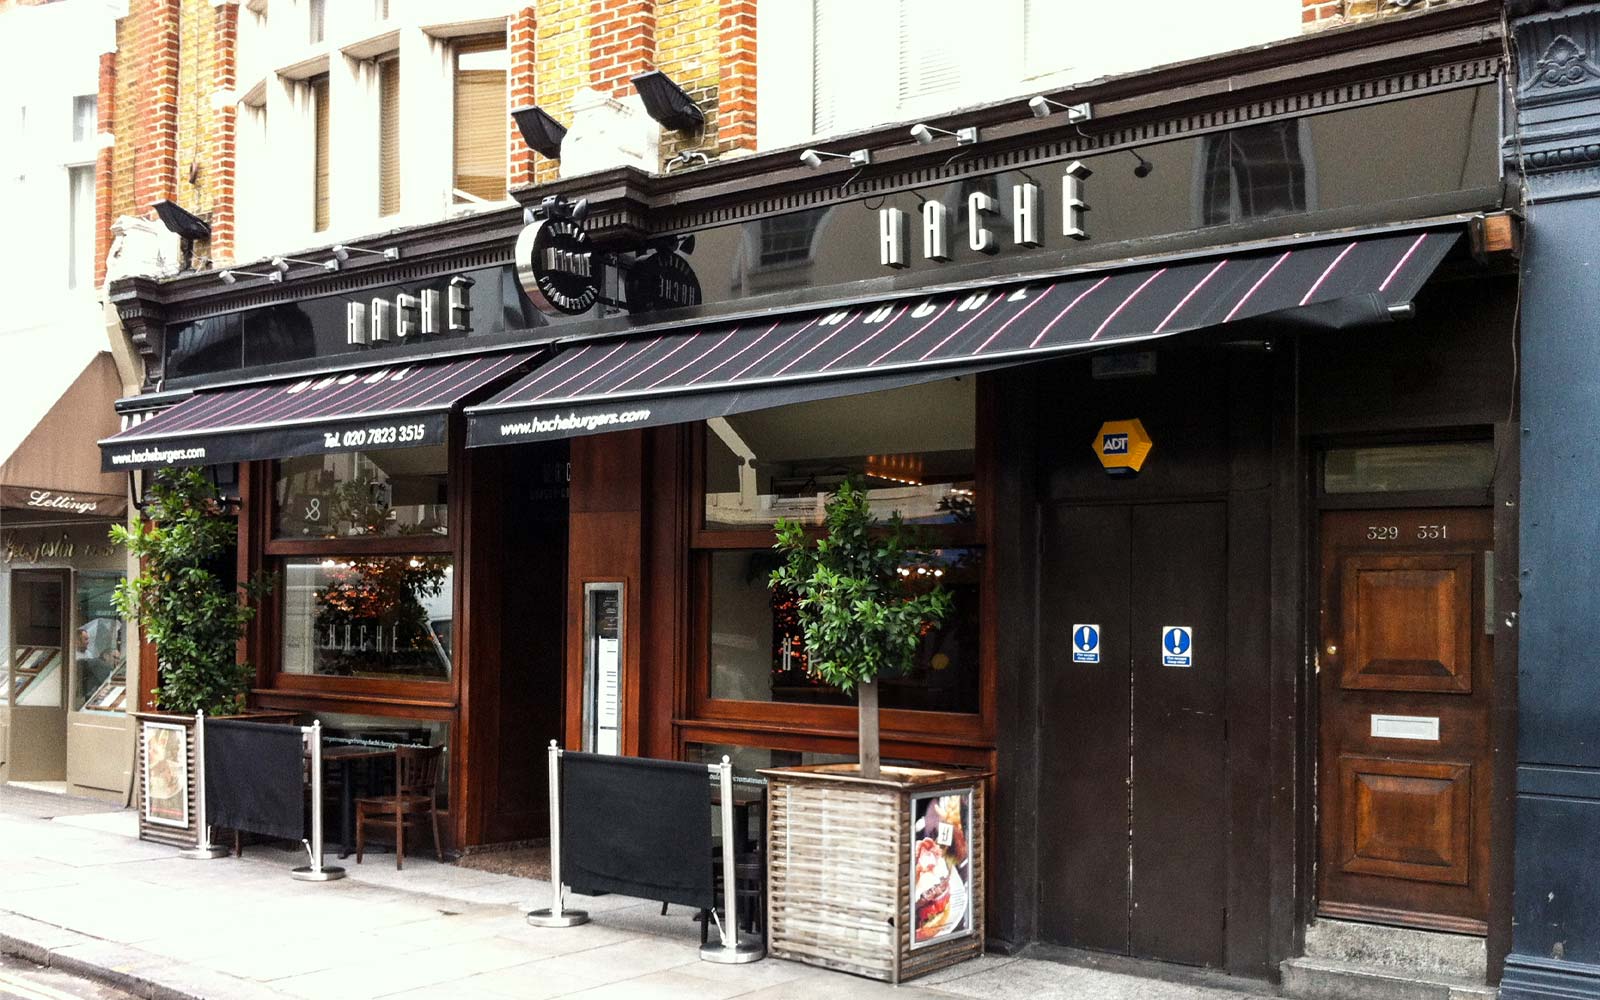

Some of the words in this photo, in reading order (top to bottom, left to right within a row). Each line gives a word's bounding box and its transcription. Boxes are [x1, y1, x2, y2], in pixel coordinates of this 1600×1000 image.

[879, 160, 1093, 266] HACHÉ
[347, 276, 473, 345] HACHÉ
[500, 410, 651, 435] www.hacheburgers.com
[343, 430, 366, 447] 020
[367, 427, 396, 445] 7823
[399, 424, 425, 442] 3515
[1103, 437, 1128, 451] ADT
[112, 447, 206, 464] www.hacheburgers.com
[27, 490, 97, 514] Lettings
[1367, 526, 1398, 540] 329
[1417, 525, 1447, 539] 331
